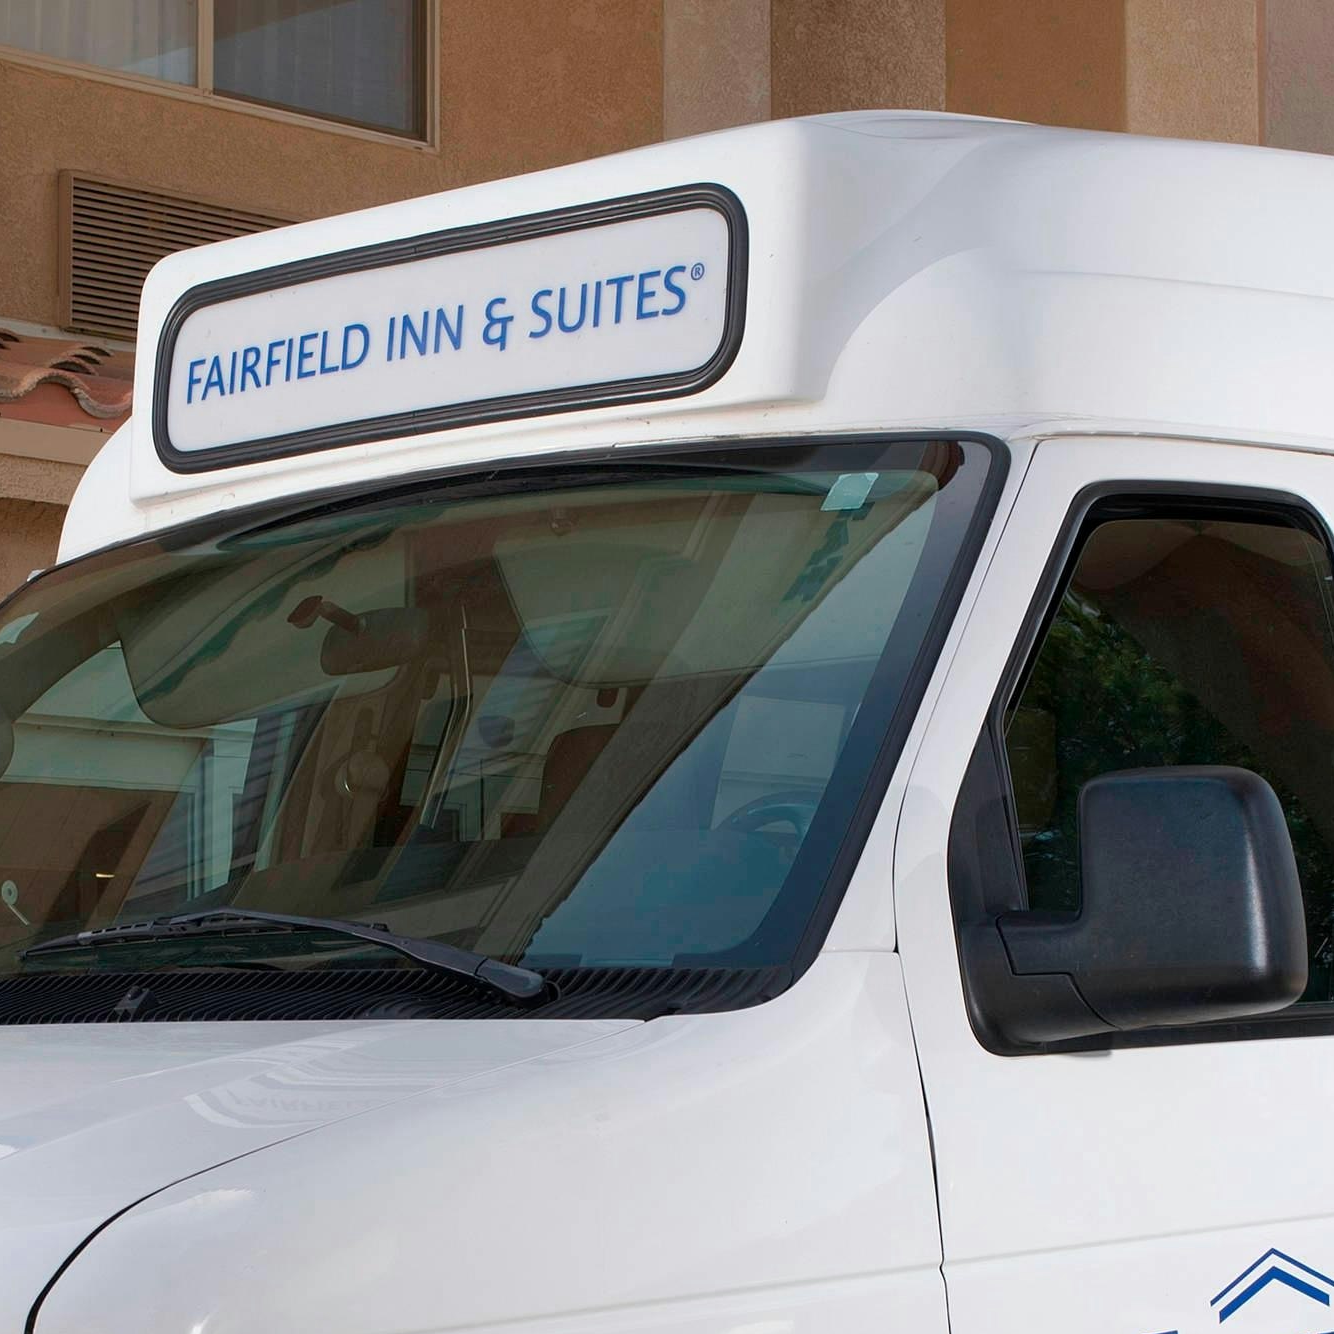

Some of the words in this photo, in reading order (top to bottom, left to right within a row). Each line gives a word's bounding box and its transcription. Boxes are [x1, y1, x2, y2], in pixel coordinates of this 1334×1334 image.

[185, 322, 371, 405] FAIRFIELD
[385, 303, 466, 363] INN
[481, 295, 516, 353] &
